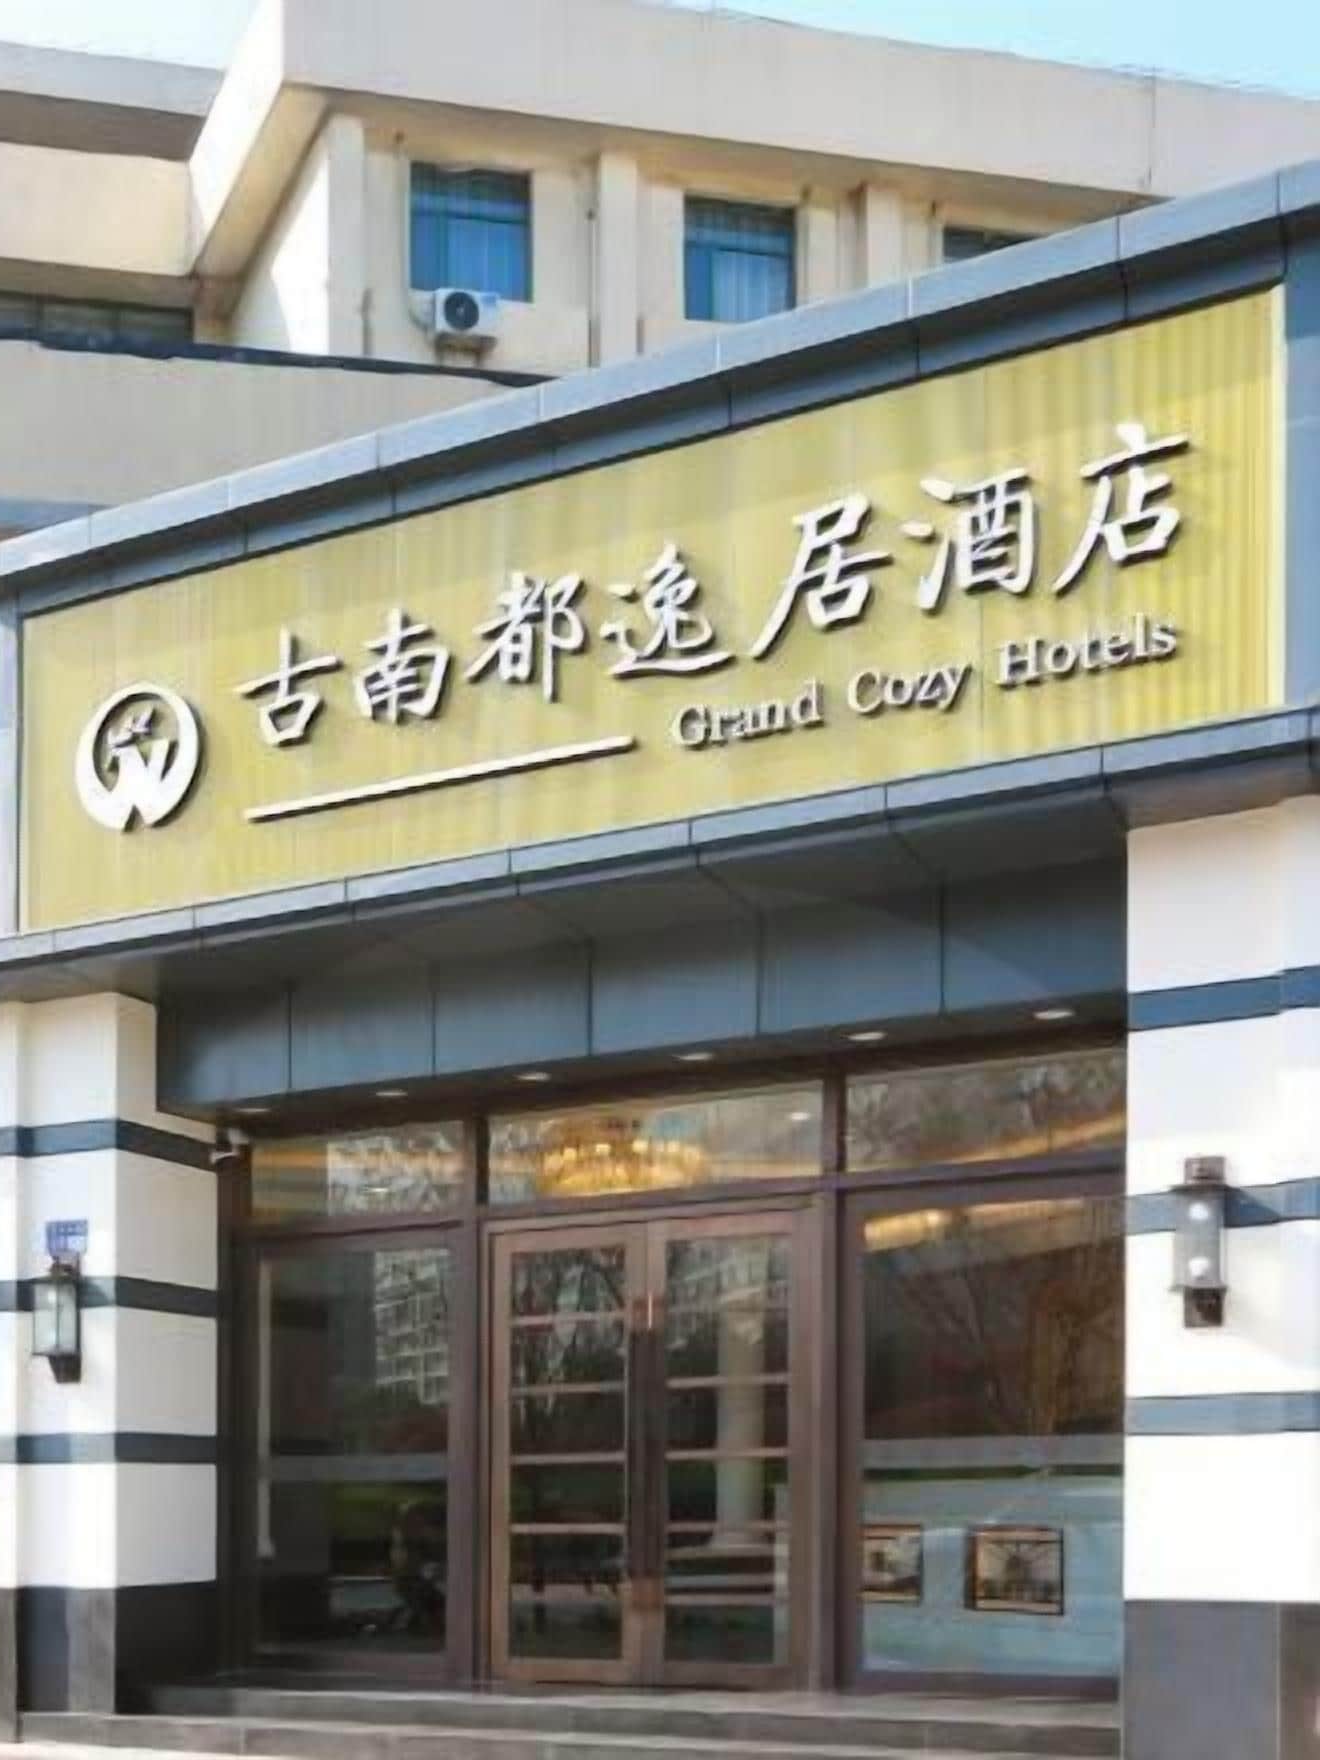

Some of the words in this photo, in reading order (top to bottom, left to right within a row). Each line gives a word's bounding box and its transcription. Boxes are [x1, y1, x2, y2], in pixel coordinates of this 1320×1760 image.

[236, 422, 1190, 747] 古南都逸居酒店
[671, 680, 824, 748] Grand
[846, 662, 971, 714] Cozy
[995, 612, 1178, 688] Hotels
